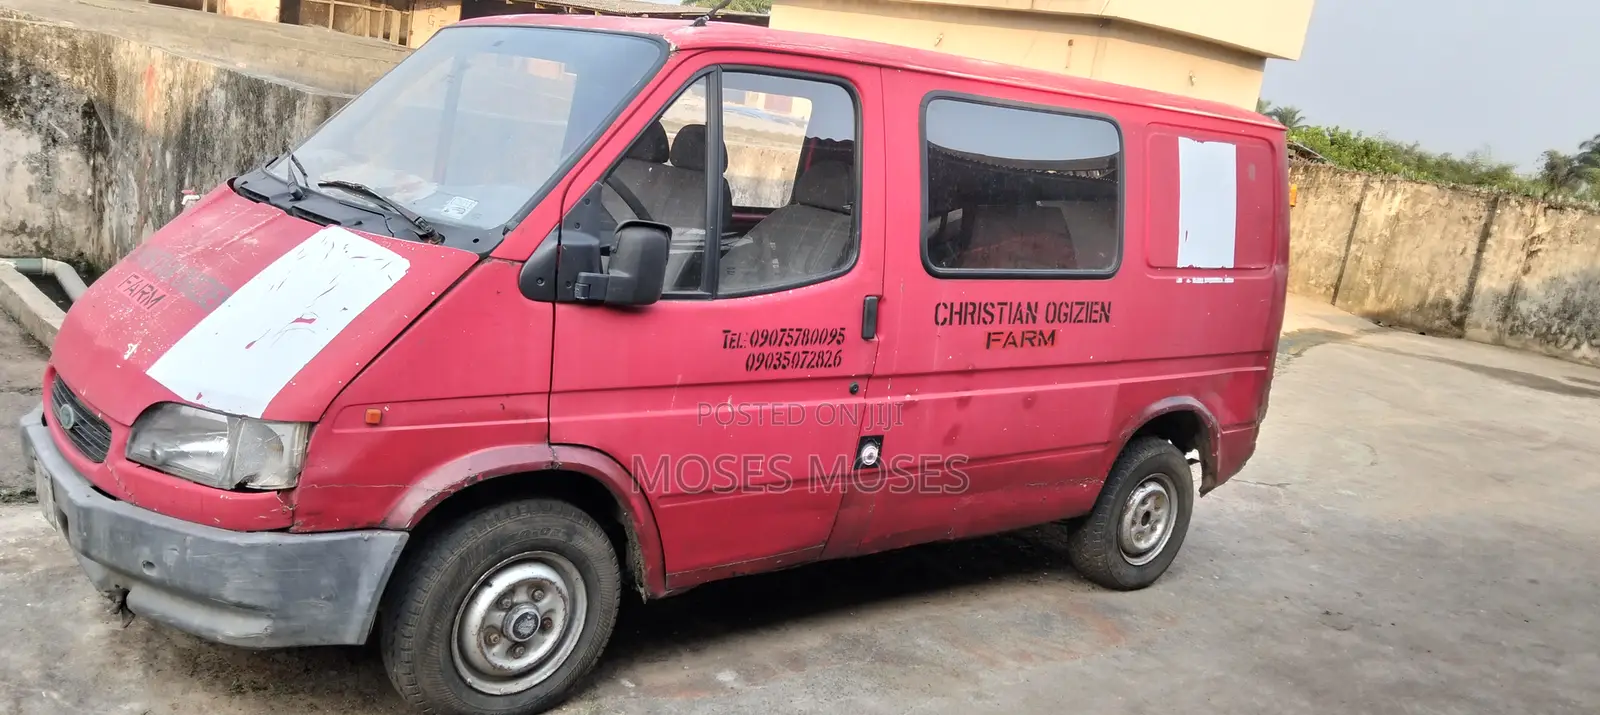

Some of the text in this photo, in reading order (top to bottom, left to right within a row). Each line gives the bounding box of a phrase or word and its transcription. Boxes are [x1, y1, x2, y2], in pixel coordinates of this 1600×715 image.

[117, 274, 166, 309] FARM
[934, 301, 1111, 326] CHRISTIAN OGIZIEN
[750, 327, 846, 348] 09075780095
[986, 329, 1057, 350] FARM
[745, 349, 843, 372] 09035072826
